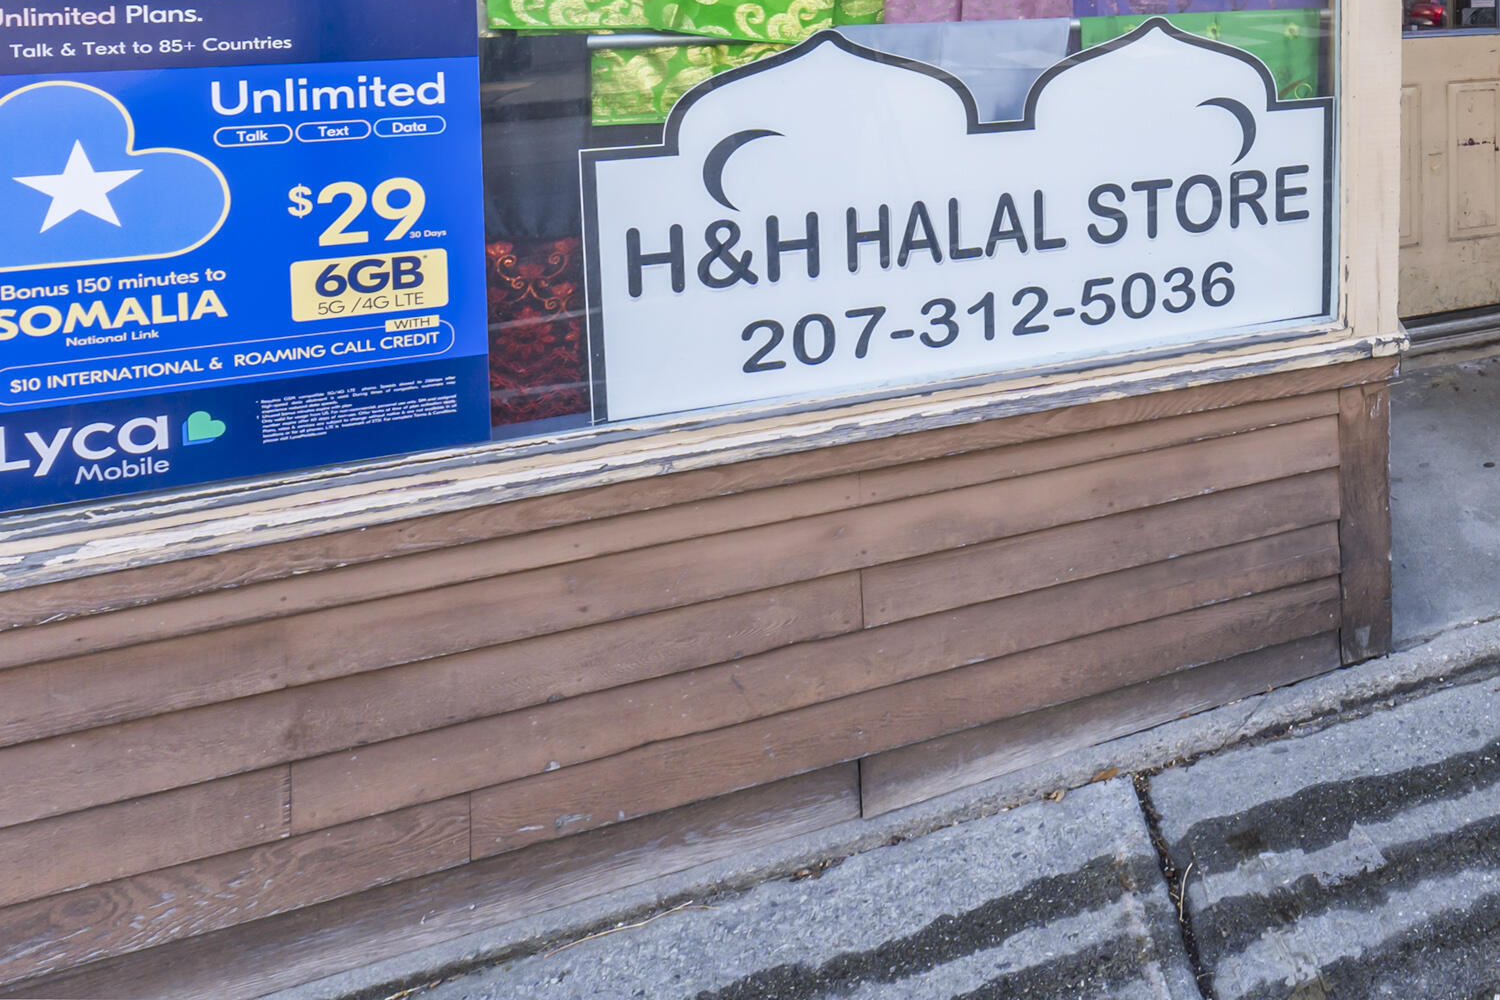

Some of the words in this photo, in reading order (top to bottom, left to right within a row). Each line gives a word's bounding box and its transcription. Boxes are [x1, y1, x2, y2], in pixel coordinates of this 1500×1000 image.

[0, 5, 116, 28] nlimited
[126, 4, 203, 25] Plans.
[9, 43, 54, 58] Talk
[60, 43, 76, 57] &
[82, 41, 126, 56] Text
[132, 41, 153, 54] to
[159, 39, 196, 53] 85+
[203, 36, 292, 52] Countries
[211, 72, 446, 116] Unlimited
[236, 129, 269, 142] Talk
[318, 124, 349, 138] Text
[392, 120, 427, 134] Data
[287, 176, 426, 247] $29
[409, 231, 422, 239] 30
[423, 230, 447, 239] Days
[626, 210, 821, 298] H&H
[848, 189, 1067, 273] HALAL
[1087, 164, 1310, 246] STORE
[1, 284, 70, 301] Bonus
[118, 272, 200, 290] minutes
[205, 268, 227, 281] to
[0, 289, 229, 341] SOMALIA
[318, 300, 345, 316] 5G
[395, 292, 424, 307] LTE
[741, 261, 1236, 374] 207-312-5036
[66, 332, 127, 347] National
[131, 329, 160, 341] Link
[393, 316, 431, 330] WITH
[10, 377, 42, 394] $10
[47, 359, 204, 389] INTERNATIONAL
[208, 356, 223, 370] &
[234, 344, 327, 368] ROAMING
[331, 339, 376, 358] CALL
[380, 331, 440, 352] CREDIT
[0, 415, 169, 477] Lyca
[74, 456, 170, 485] Mobile
